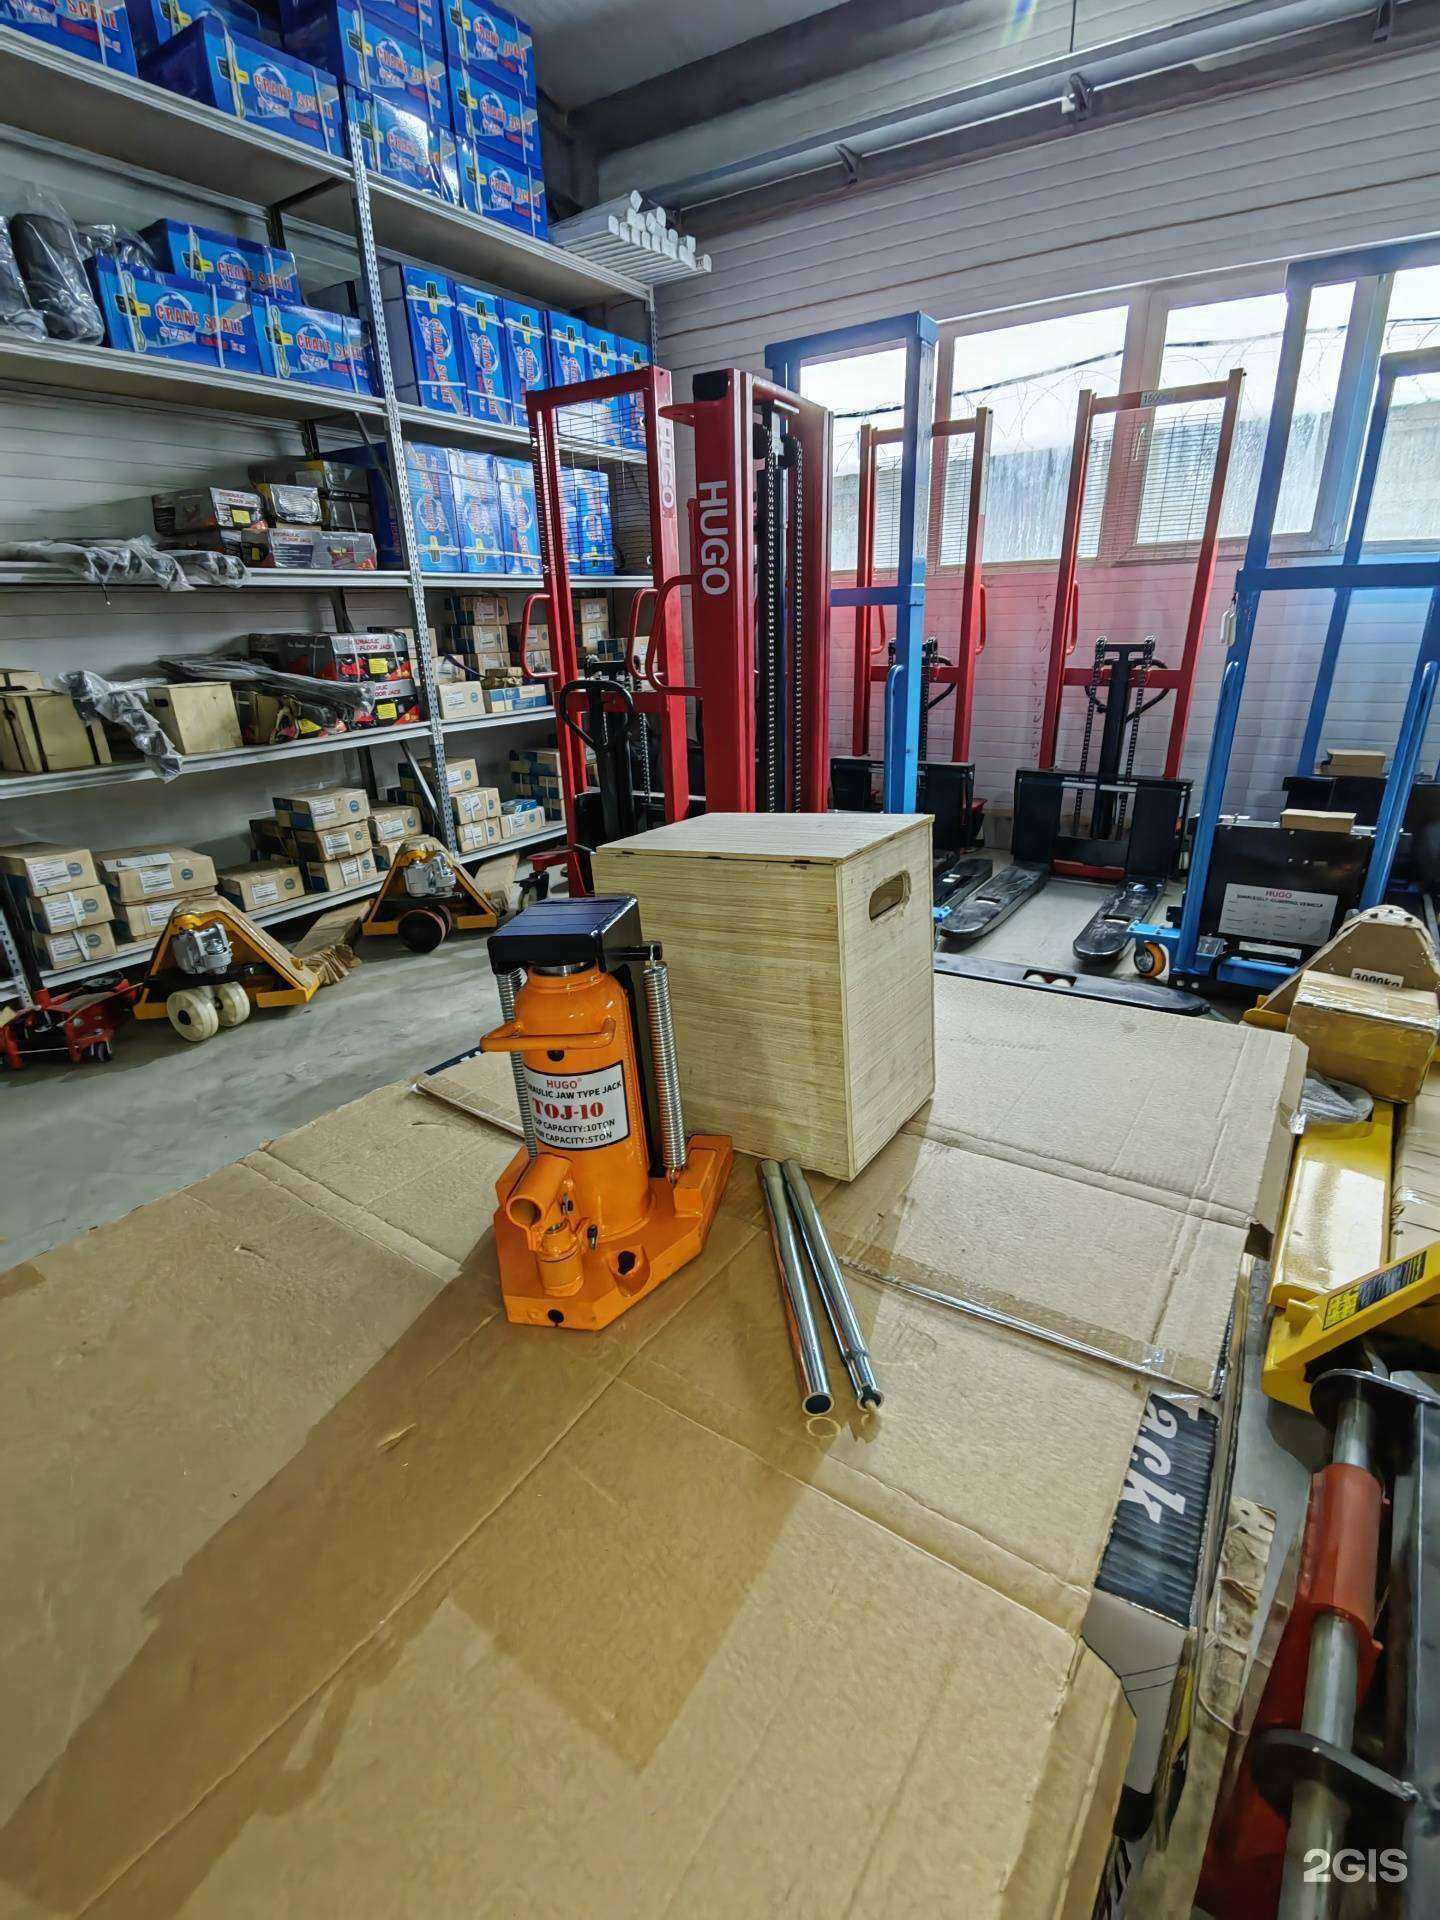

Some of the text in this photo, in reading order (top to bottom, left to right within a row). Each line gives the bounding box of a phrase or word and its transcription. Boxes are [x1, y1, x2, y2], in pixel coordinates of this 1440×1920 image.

[698, 480, 730, 596] HUGO
[1265, 889, 1293, 899] HUGO
[546, 1079, 578, 1089] HUGO
[556, 1091, 575, 1100] JAW
[577, 1088, 601, 1099] TYPE
[602, 1080, 622, 1094] JACK
[532, 1097, 604, 1120] TOJ-10
[1121, 1395, 1199, 1523] ack
